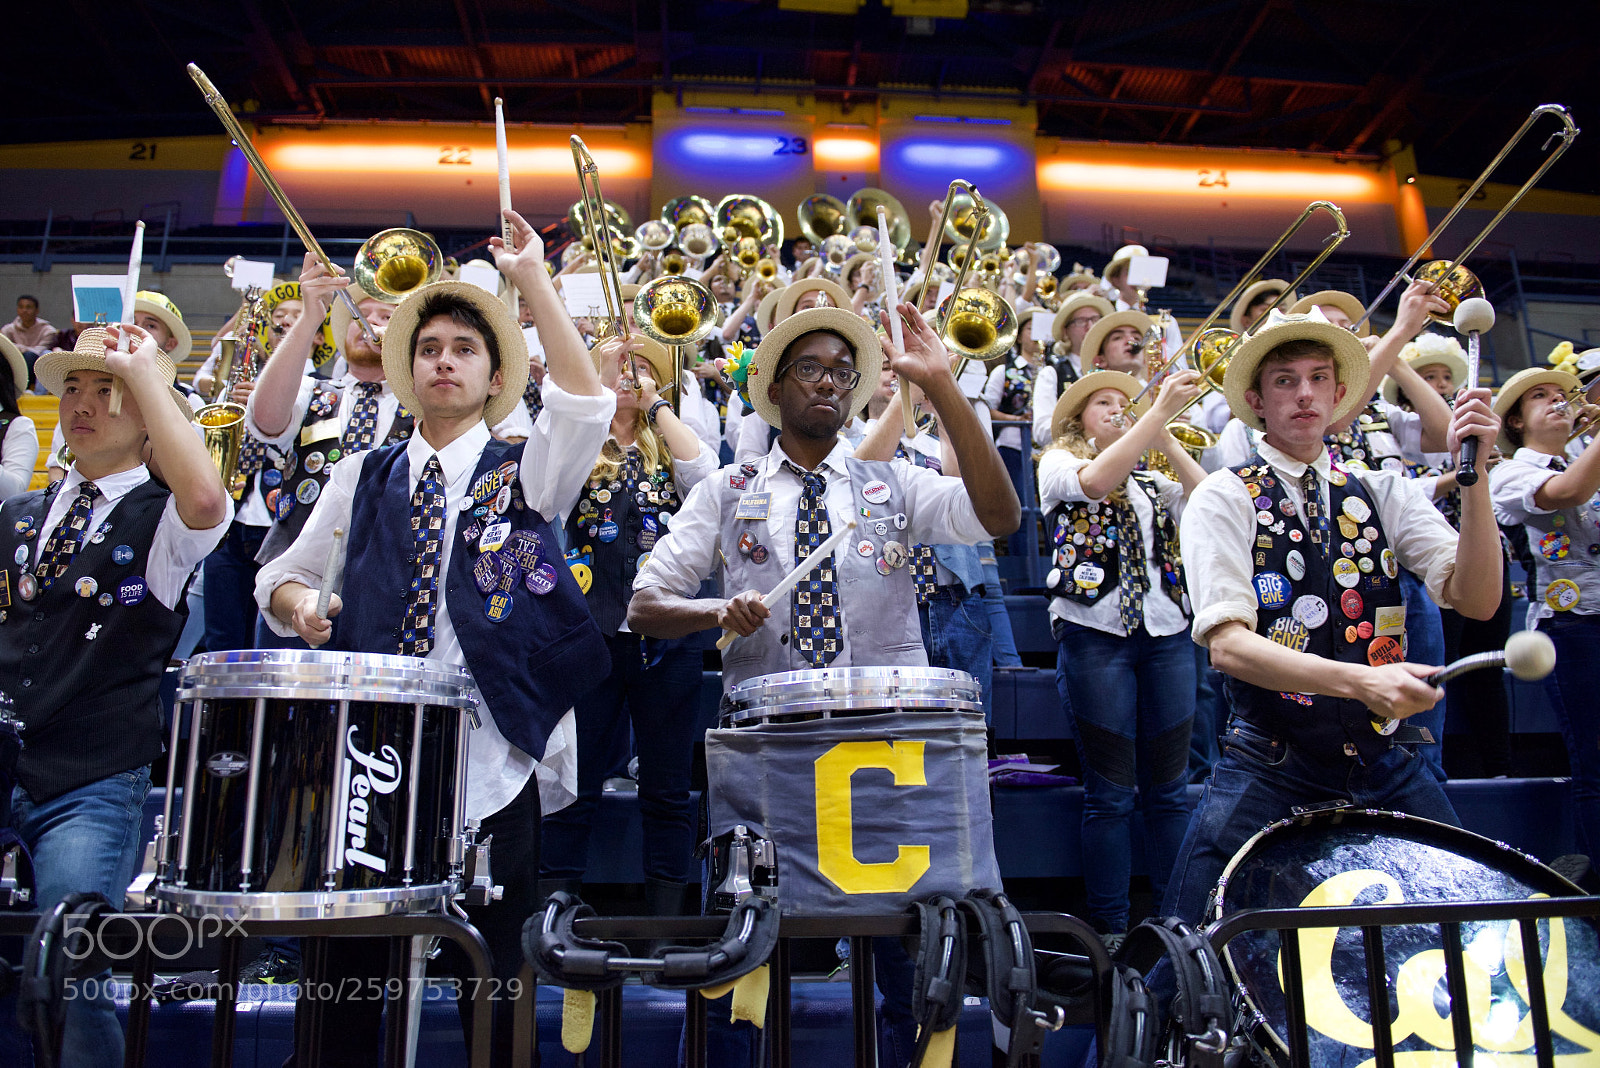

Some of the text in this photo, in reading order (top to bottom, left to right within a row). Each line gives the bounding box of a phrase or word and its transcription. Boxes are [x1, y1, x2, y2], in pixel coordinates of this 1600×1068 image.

[129, 143, 157, 161] 21
[774, 137, 807, 155] 23
[438, 146, 472, 165] 22
[1198, 169, 1229, 188] 24
[275, 284, 294, 300] GO
[474, 476, 500, 500] GIVE
[475, 470, 493, 489] BIG
[279, 497, 290, 512] BIG
[518, 538, 536, 554] CAL
[473, 552, 494, 582] BEAT
[510, 547, 539, 570] BEAT
[19, 576, 31, 598] T
[481, 569, 495, 587] CAL
[528, 571, 554, 591] Kerry
[1258, 577, 1282, 594] BIG
[121, 584, 143, 593] FOOD
[128, 590, 143, 598] LIFE
[1261, 590, 1285, 604] GIVE
[490, 594, 509, 609] BEAT
[488, 605, 503, 619] ASU
[1274, 618, 1300, 635] BIG
[1272, 630, 1305, 652] GIVE
[1370, 639, 1396, 662] BUILD
[1381, 652, 1393, 663] THE
[346, 724, 403, 873] Pearl
[814, 740, 931, 896] C
[1277, 869, 1600, 1055] Cal
